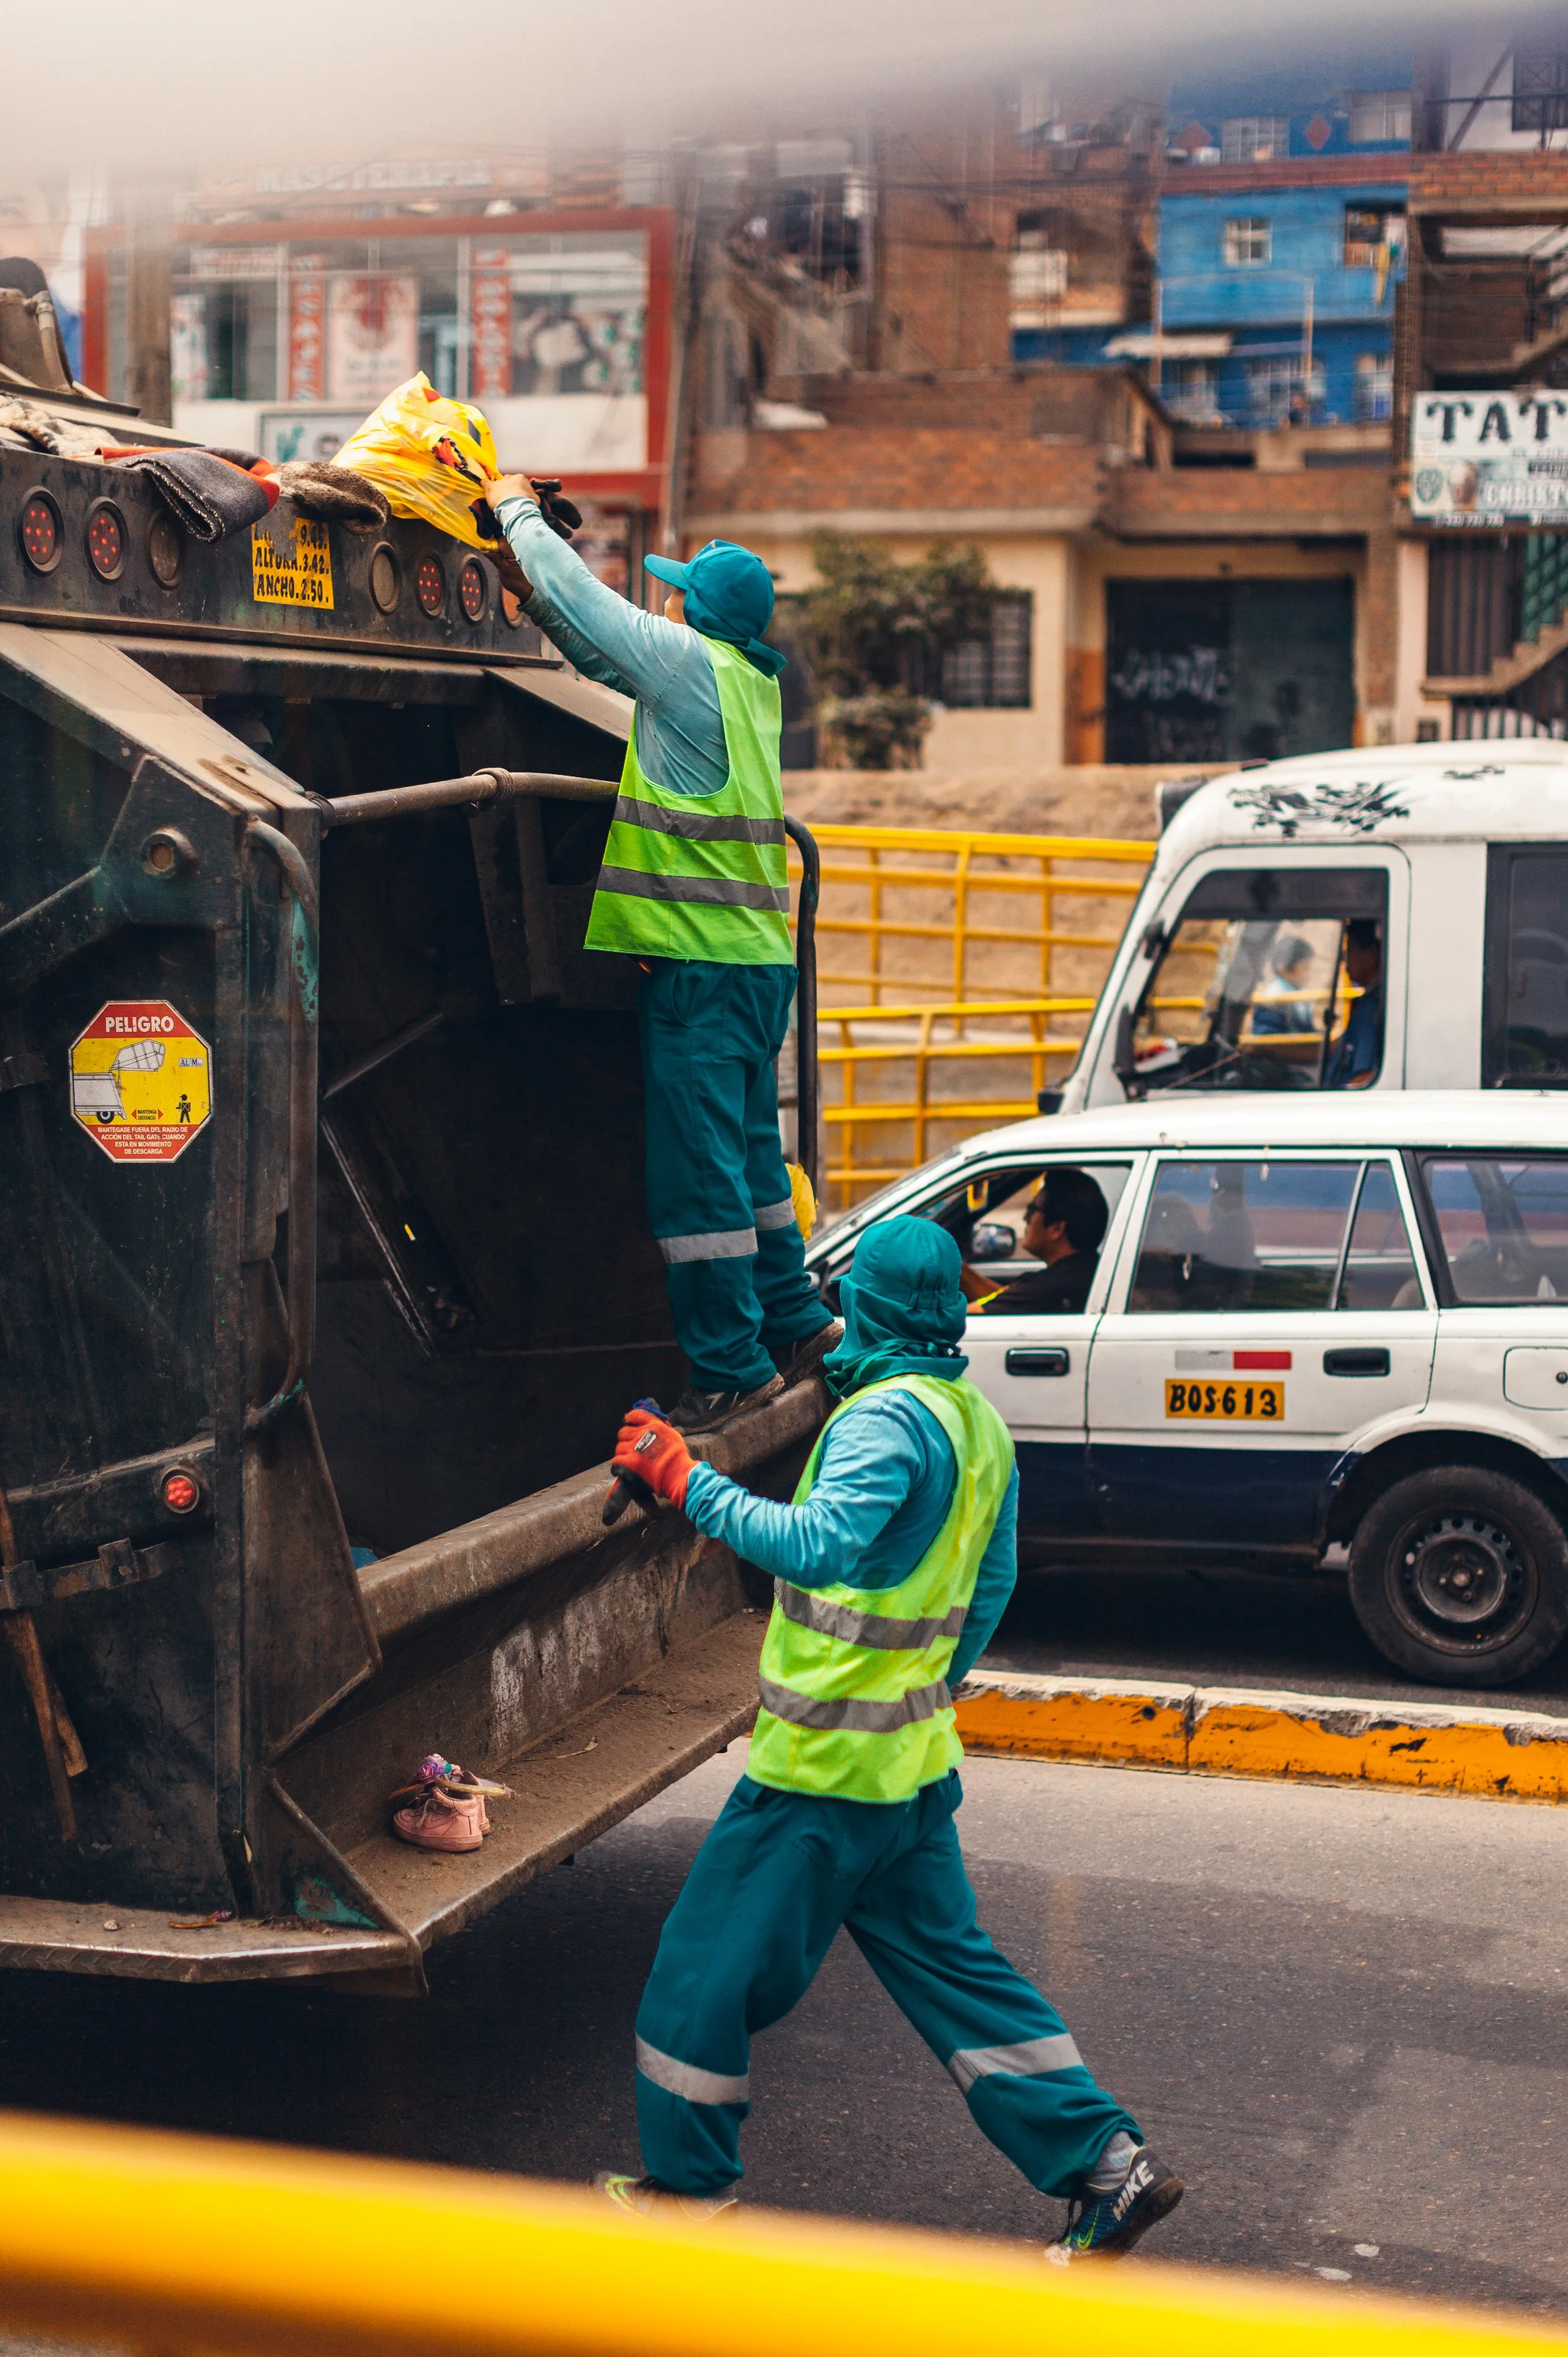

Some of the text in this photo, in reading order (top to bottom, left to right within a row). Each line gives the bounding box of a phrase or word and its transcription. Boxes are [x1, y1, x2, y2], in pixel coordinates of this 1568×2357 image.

[1426, 401, 1568, 442] TAT
[105, 1016, 174, 1032] PELIGRO
[1112, 2160, 1155, 2222] NIKE
